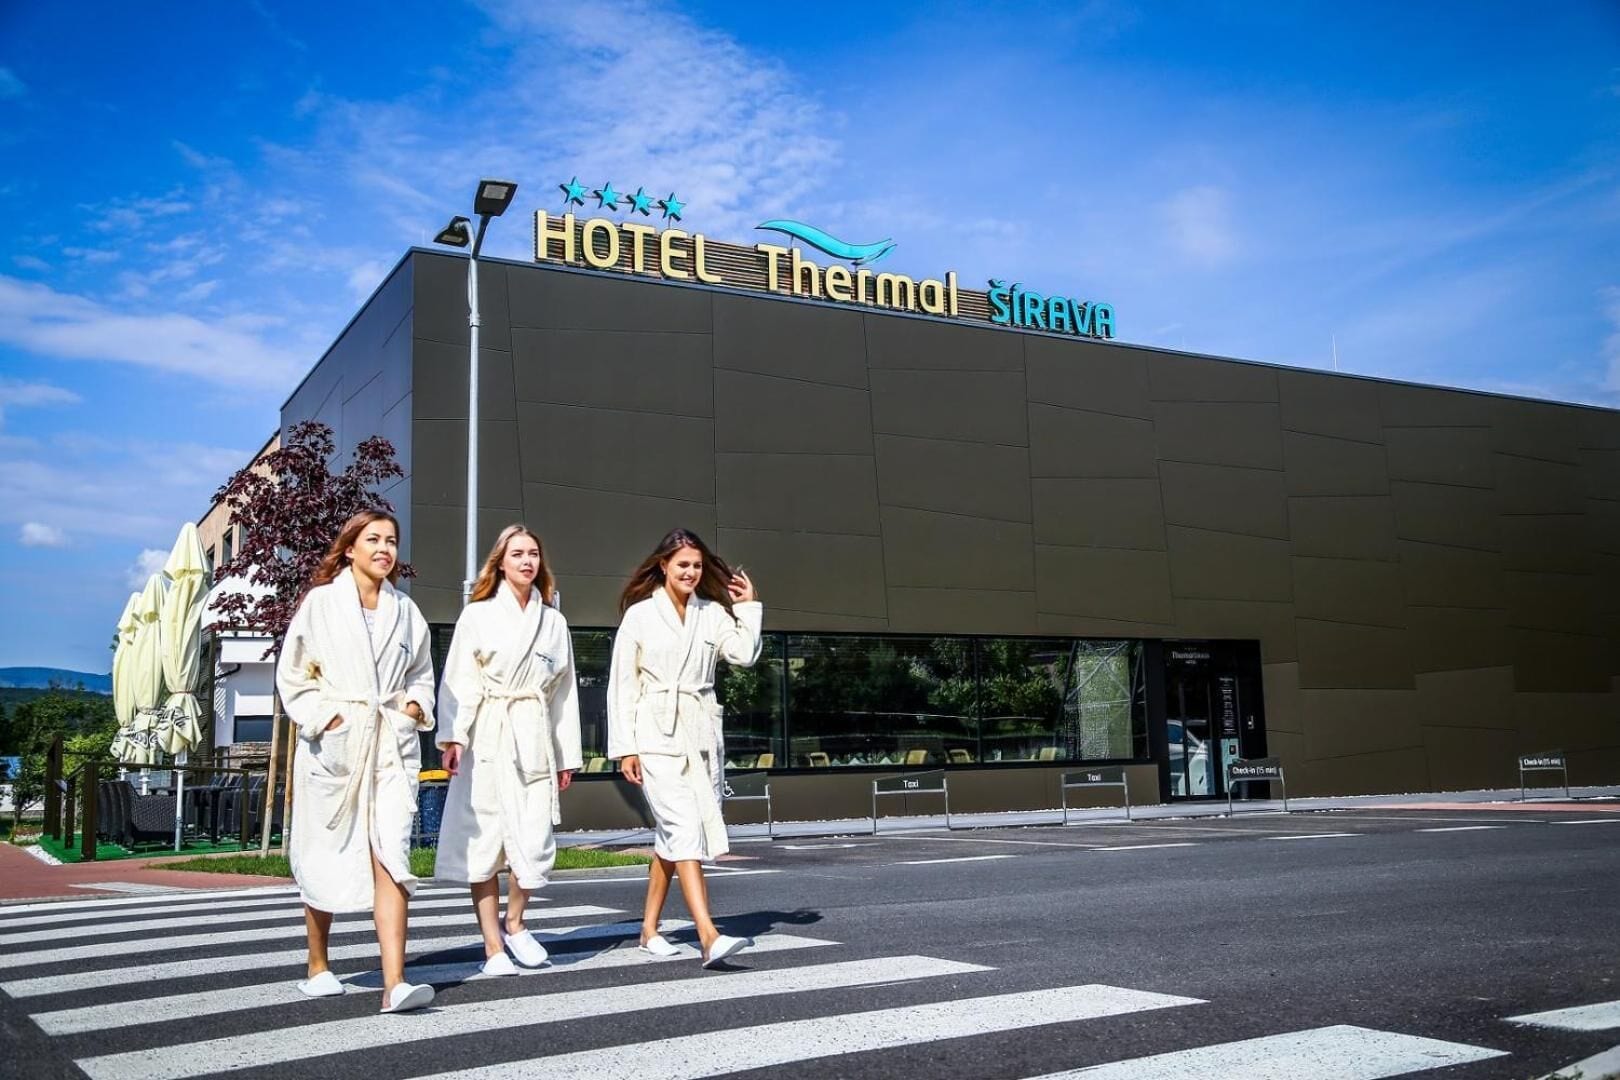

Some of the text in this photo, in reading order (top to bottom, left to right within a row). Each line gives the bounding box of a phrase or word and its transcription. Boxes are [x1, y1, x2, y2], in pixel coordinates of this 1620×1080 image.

[535, 210, 1116, 339] HOTEL Thermal ŠÍRAVA
[1232, 766, 1256, 775] Check-in
[1087, 773, 1102, 781] Taxi
[903, 779, 919, 789] Taxi
